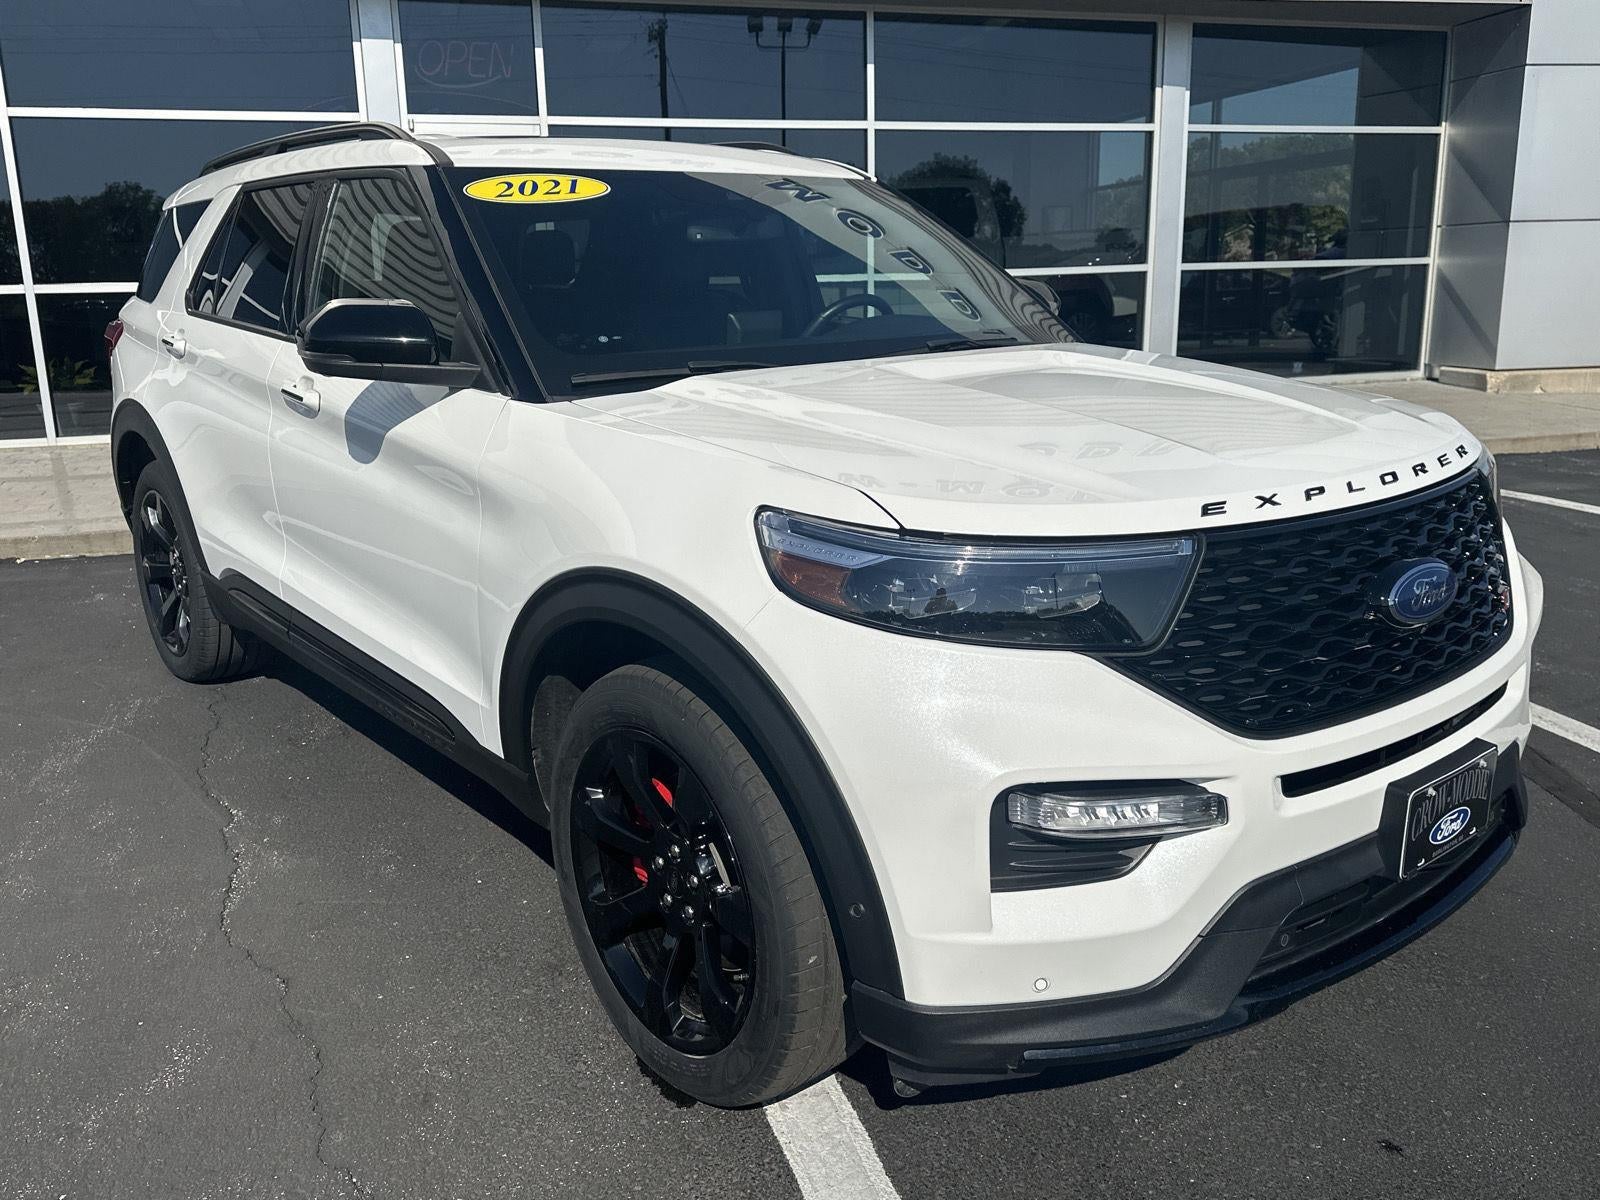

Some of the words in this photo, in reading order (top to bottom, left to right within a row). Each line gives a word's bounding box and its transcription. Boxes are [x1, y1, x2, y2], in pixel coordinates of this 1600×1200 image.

[417, 39, 514, 79] OPEN
[495, 178, 581, 198] 2021
[1200, 444, 1469, 518] EXPLORER
[1411, 575, 1453, 609] Ford
[1411, 768, 1490, 842] CROW-MODDIE
[1437, 813, 1464, 841] Ford
